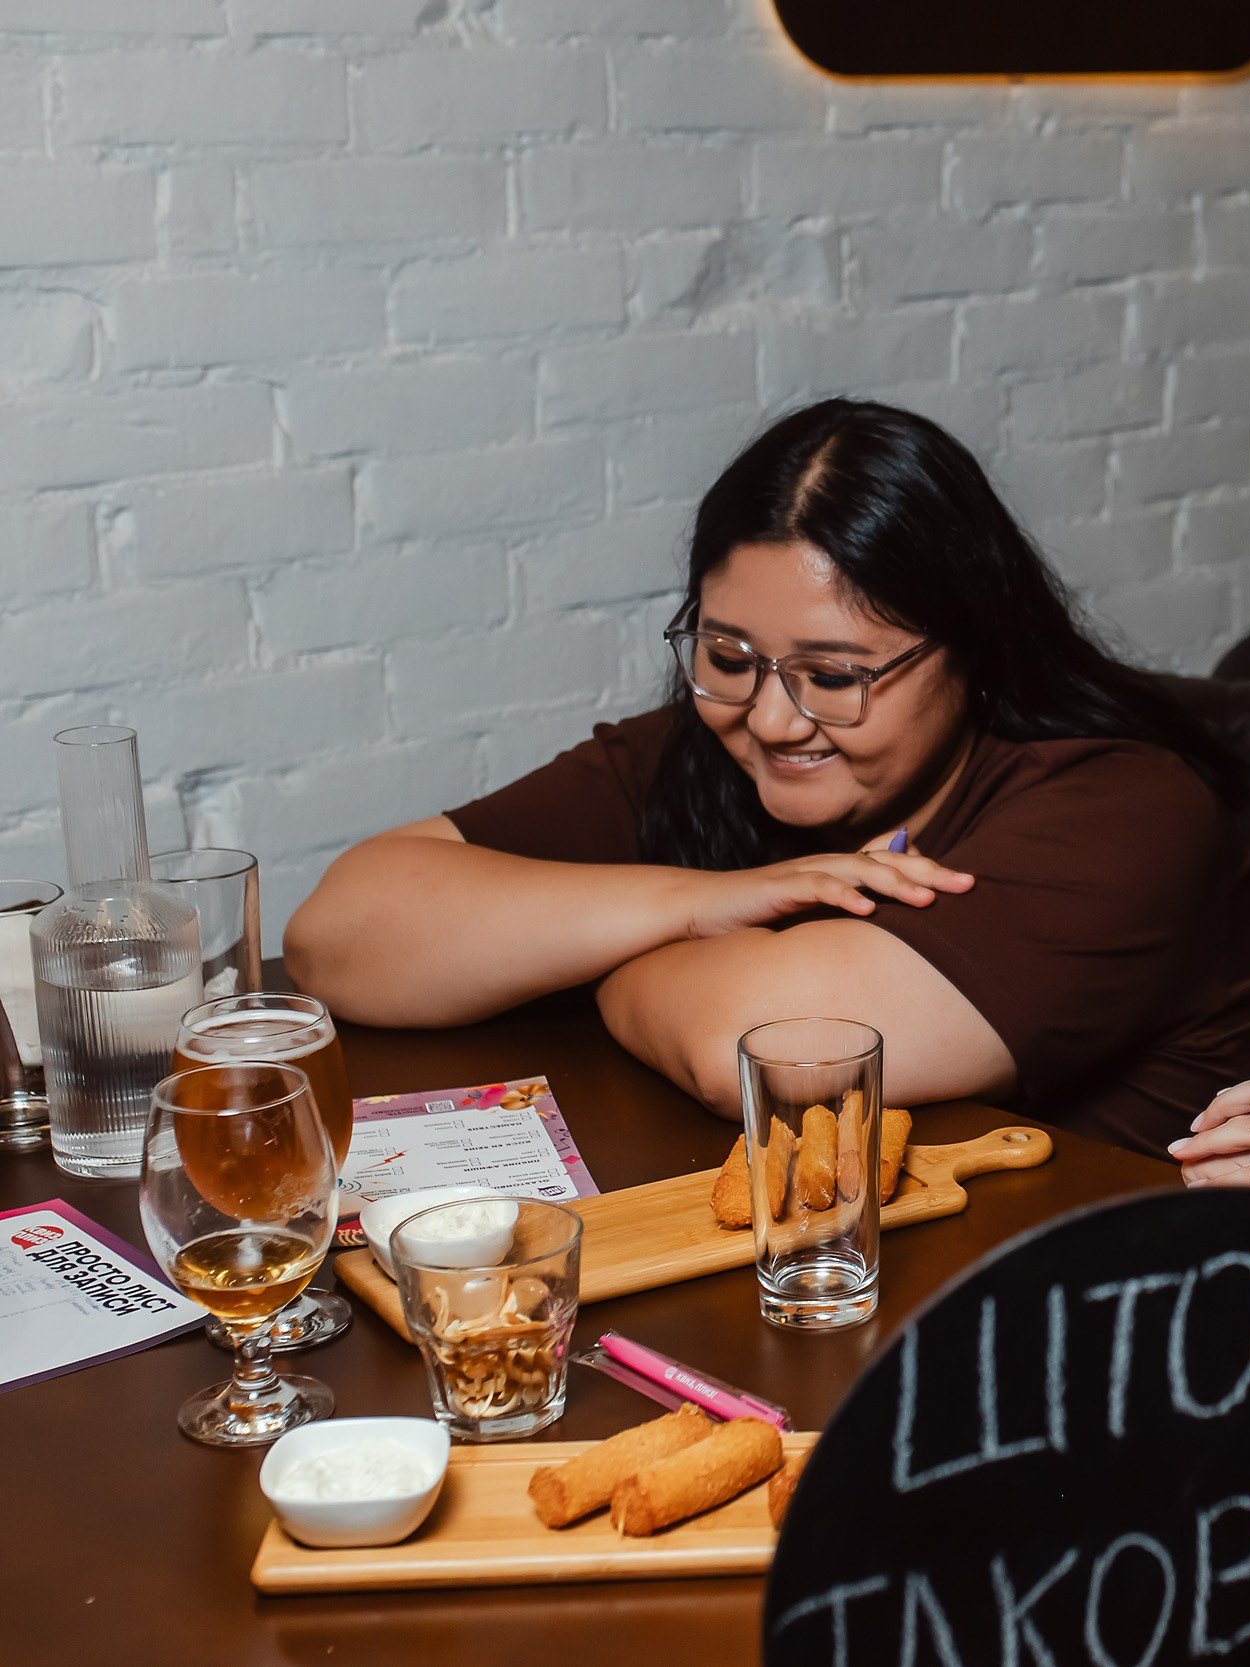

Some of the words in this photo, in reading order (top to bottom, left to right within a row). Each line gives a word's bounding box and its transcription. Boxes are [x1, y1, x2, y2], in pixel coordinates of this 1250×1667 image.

[25, 1248, 79, 1274] ДЛЯ
[63, 1270, 141, 1317] ЗАПИСИ
[56, 1240, 132, 1286] ПРОСТО
[118, 1284, 178, 1314] ЛИСТ
